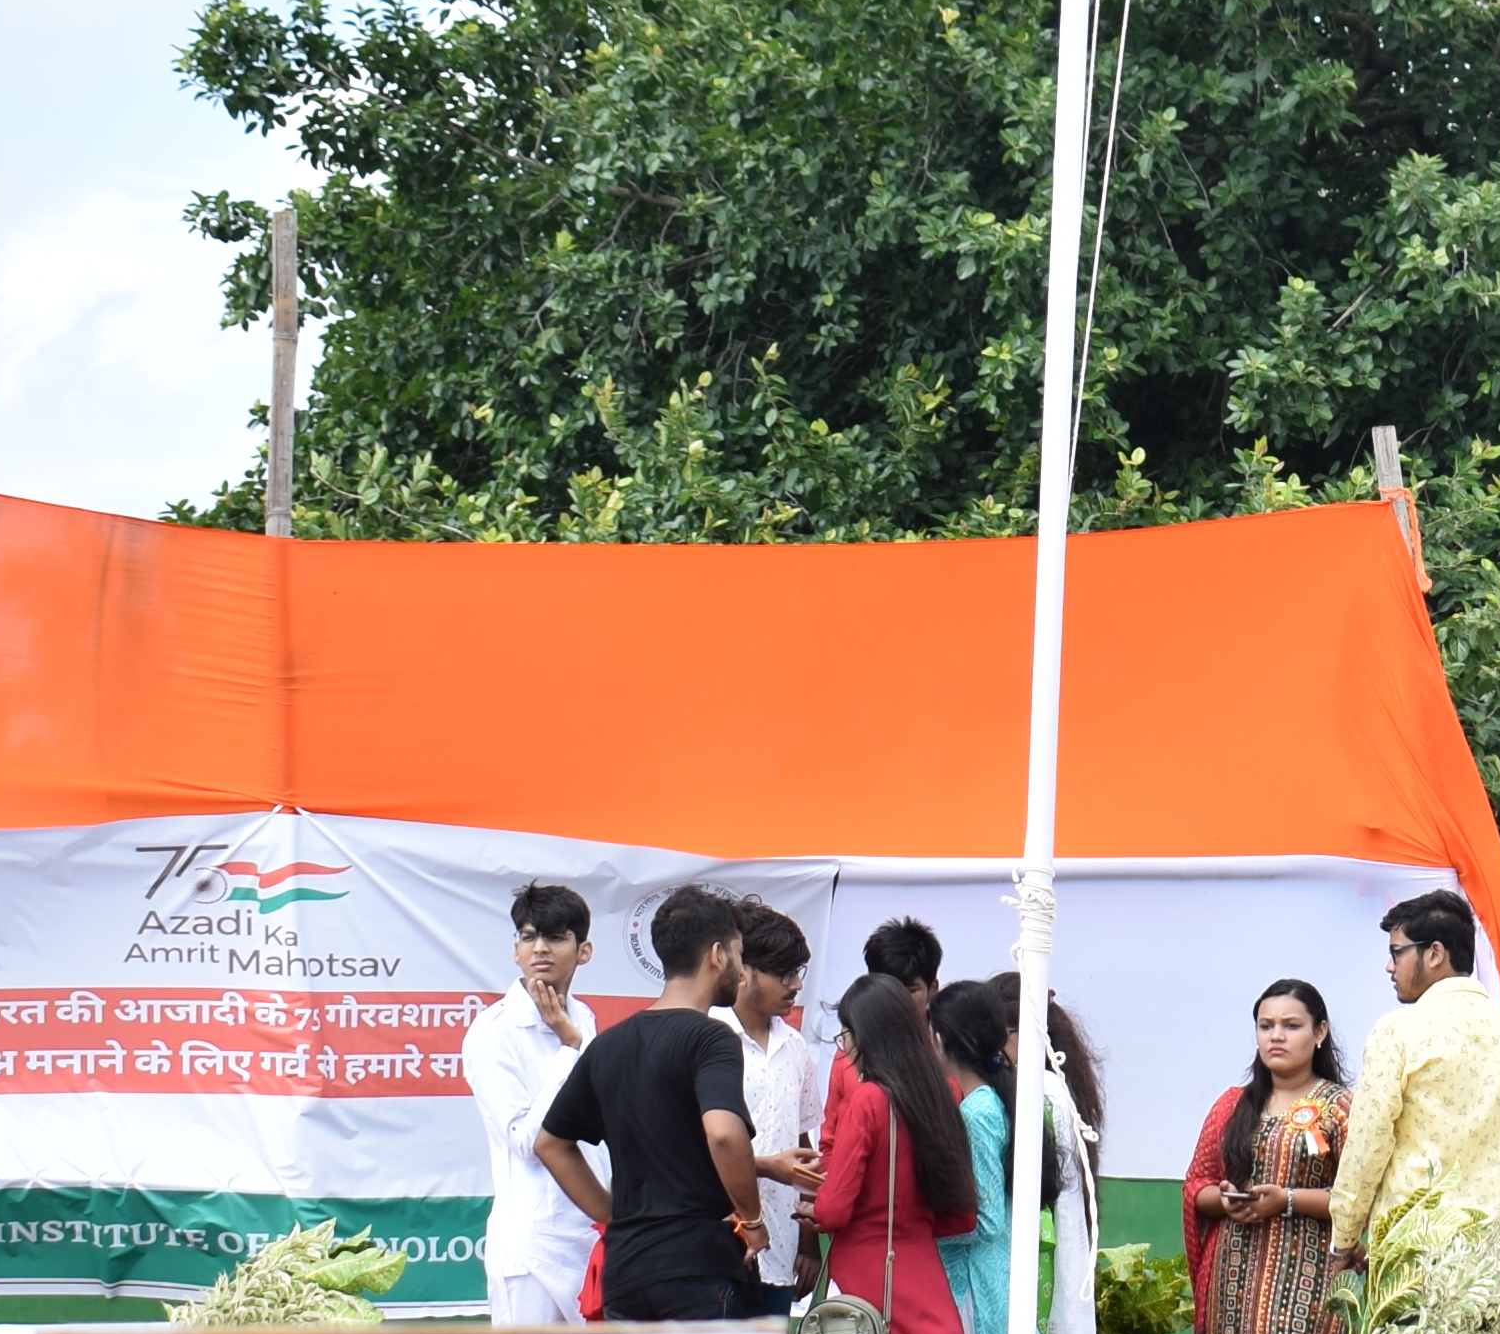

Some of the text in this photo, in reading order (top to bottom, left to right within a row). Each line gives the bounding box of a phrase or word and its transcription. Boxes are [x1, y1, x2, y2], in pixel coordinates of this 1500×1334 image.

[136, 909, 253, 936] Azadi
[264, 924, 299, 947] Ka
[123, 942, 402, 978] Amrit Mahotsav
[54, 990, 107, 1024] की
[113, 992, 249, 1026] आजादी
[253, 993, 289, 1027] के
[294, 1007, 321, 1032] 75
[324, 994, 488, 1028] गौरवशाली
[24, 1039, 127, 1075] मनाने
[133, 1039, 173, 1075] के
[179, 1040, 253, 1083] लिए
[260, 1043, 311, 1079] गर्व
[315, 1044, 339, 1080] से
[343, 1044, 424, 1085] हमारे
[217, 1231, 270, 1259] OF
